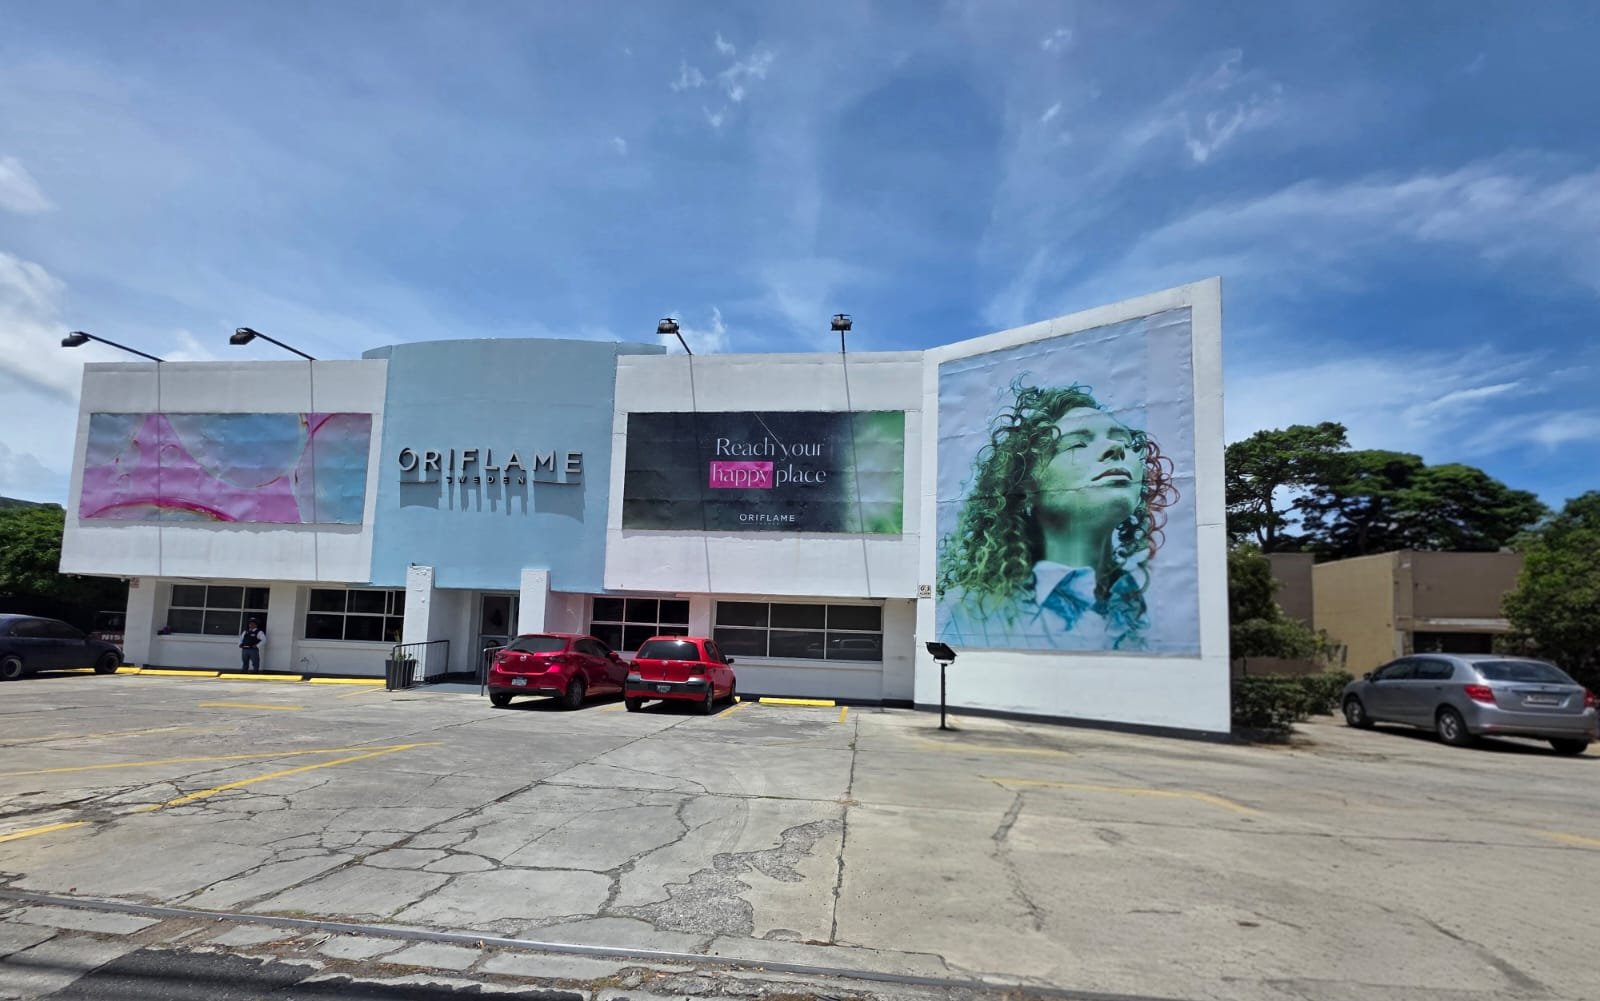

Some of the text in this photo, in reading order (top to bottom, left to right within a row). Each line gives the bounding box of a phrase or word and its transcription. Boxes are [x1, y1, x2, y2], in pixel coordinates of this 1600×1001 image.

[398, 447, 584, 473] ORIFLAME
[716, 437, 825, 461] Reach your
[712, 463, 827, 488] happy place
[739, 513, 796, 522] ORIFLAME
